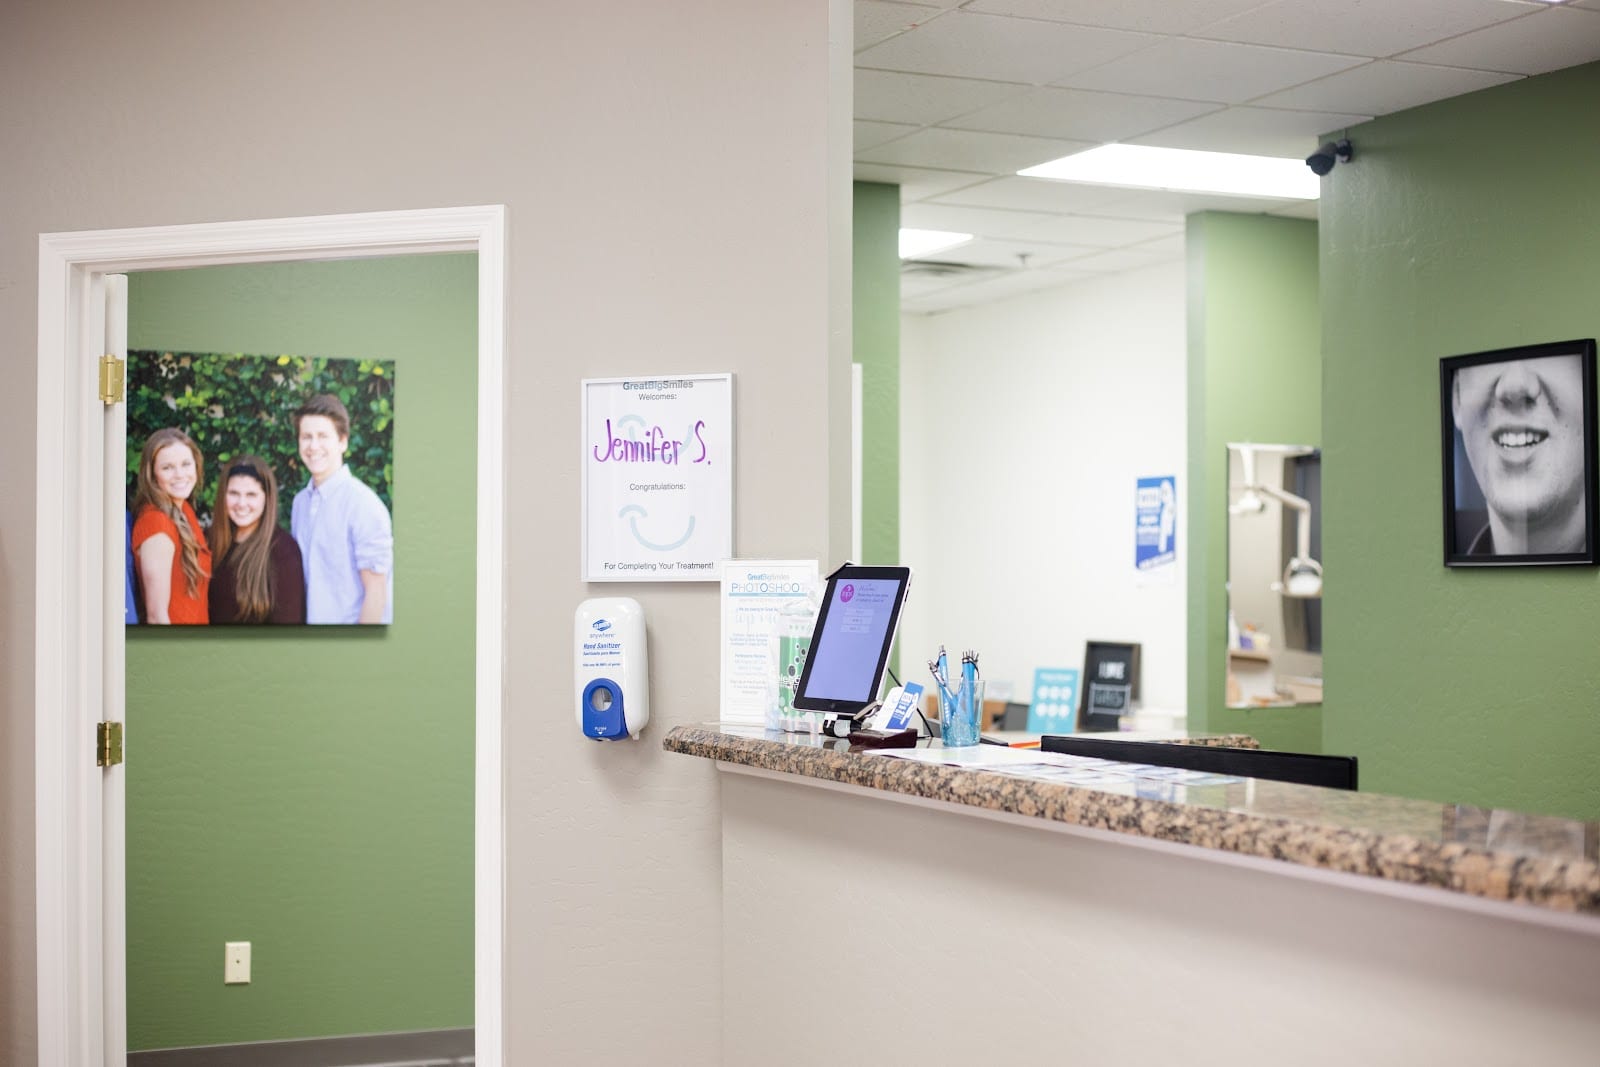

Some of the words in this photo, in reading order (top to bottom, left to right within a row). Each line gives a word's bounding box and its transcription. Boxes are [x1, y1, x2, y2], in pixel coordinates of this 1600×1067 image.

[623, 380, 694, 390] GreatBigSmiles
[594, 419, 682, 465] Jennifer
[693, 420, 712, 465] S.
[630, 483, 686, 492] Congratulations:
[617, 562, 656, 571] Completing
[676, 562, 714, 570] Treatment!
